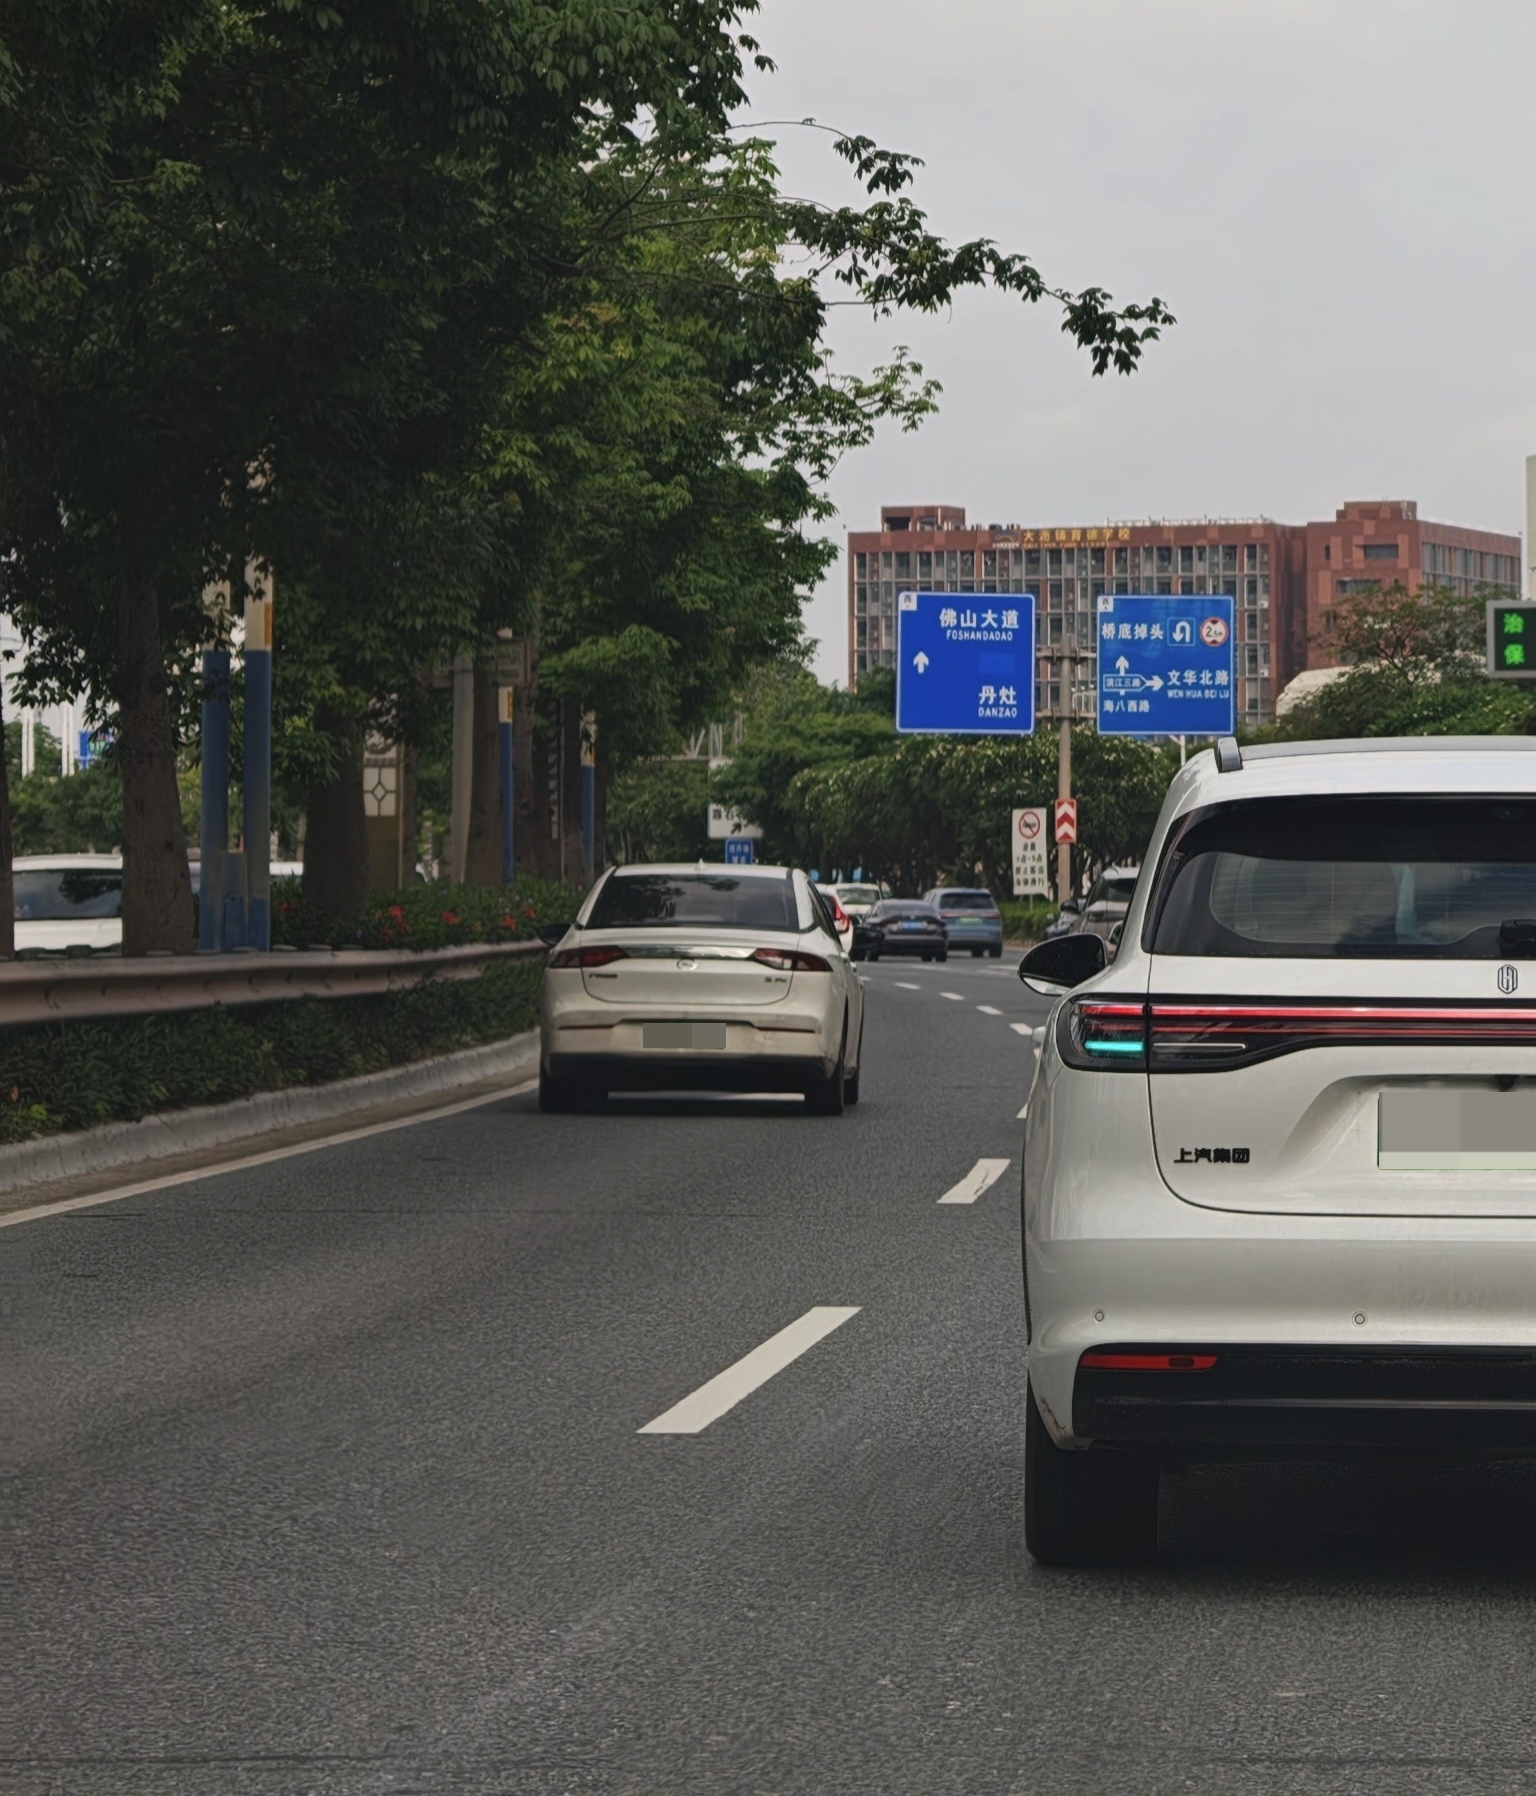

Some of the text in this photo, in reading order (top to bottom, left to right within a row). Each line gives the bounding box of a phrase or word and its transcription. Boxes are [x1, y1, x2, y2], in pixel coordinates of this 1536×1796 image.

[939, 608, 1019, 629] 佛山大道
[946, 629, 1013, 641] FOSHANDADAO
[1101, 622, 1164, 640] 桥底掉头
[1167, 669, 1229, 686] 文华北路
[978, 685, 1018, 705] 丹灶
[1220, 689, 1229, 698] LU
[978, 707, 1018, 718] DANZAO
[1173, 1147, 1250, 1163] 上汽集团
